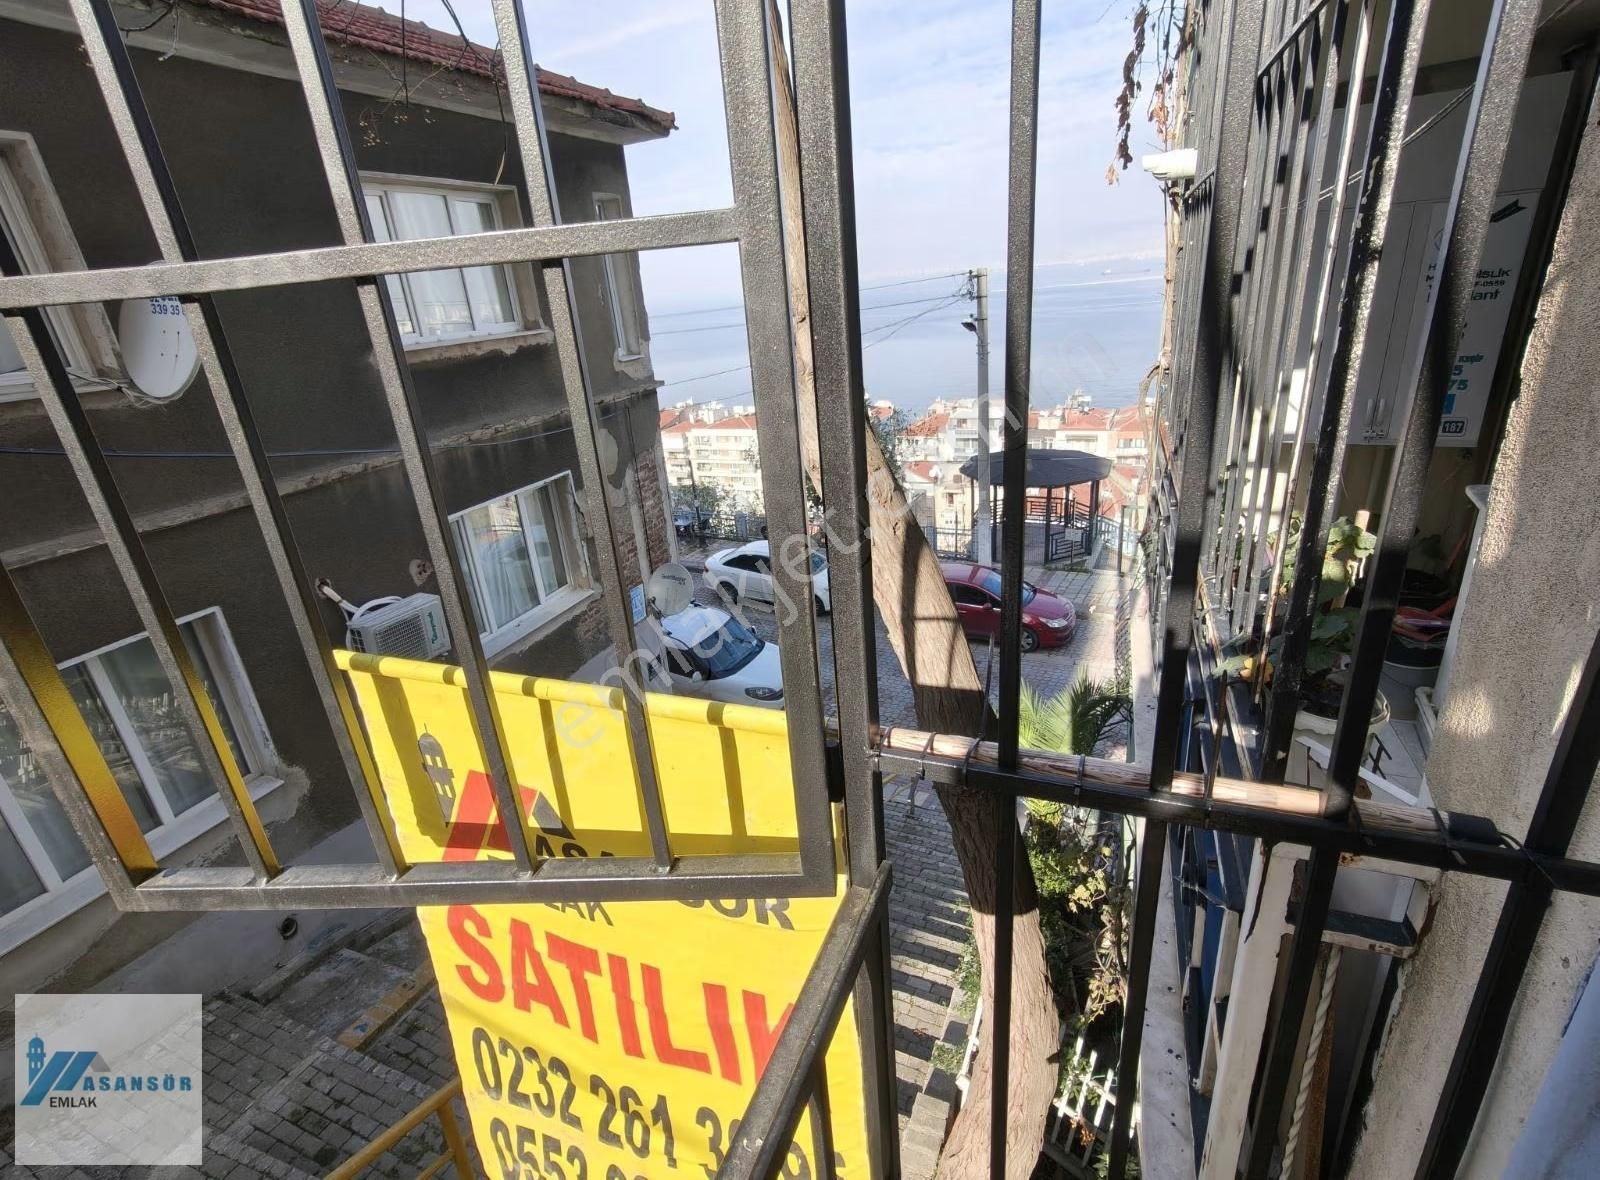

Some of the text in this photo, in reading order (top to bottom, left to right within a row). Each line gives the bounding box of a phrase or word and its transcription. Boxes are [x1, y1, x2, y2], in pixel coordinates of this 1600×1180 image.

[150, 303, 168, 315] 339
[472, 1026, 584, 1133] 0232
[589, 1074, 678, 1169] 261
